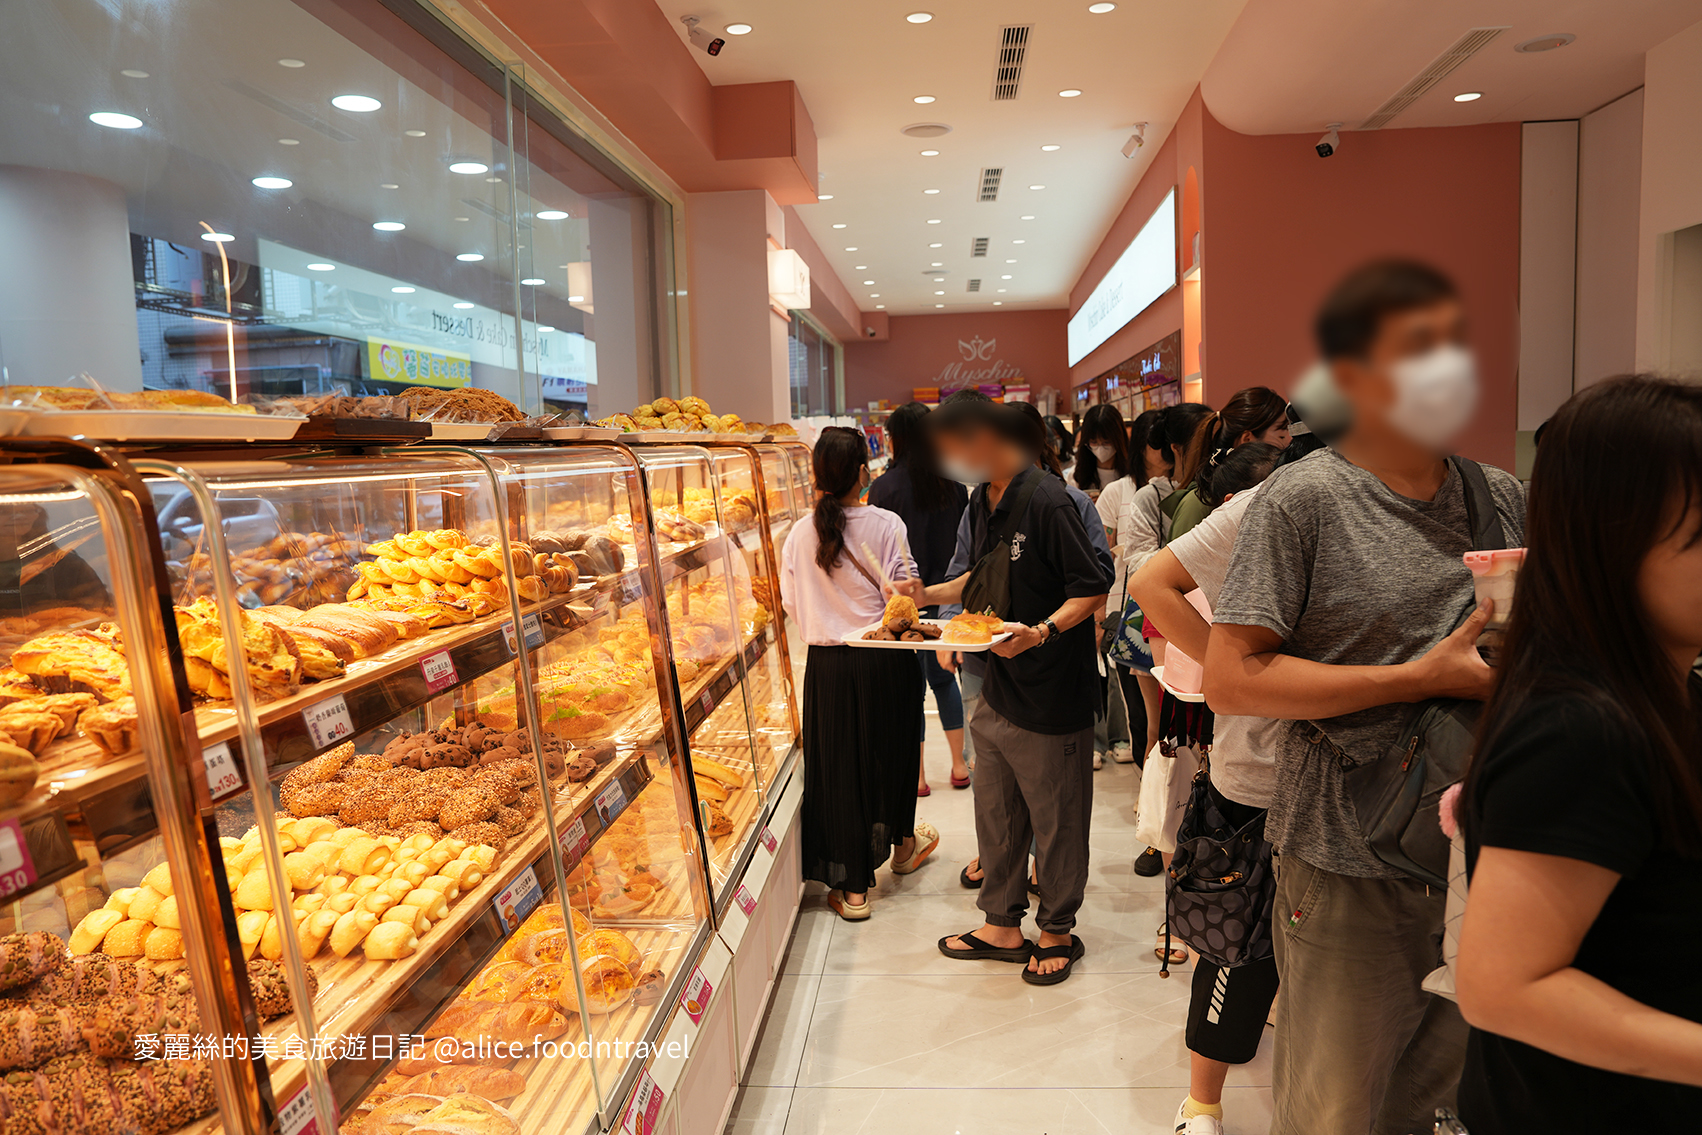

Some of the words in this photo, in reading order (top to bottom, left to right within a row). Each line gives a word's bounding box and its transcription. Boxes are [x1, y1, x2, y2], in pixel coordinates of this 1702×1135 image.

[932, 359, 1023, 389] Myschin
[334, 722, 346, 735] 40
[218, 773, 237, 790] 130
